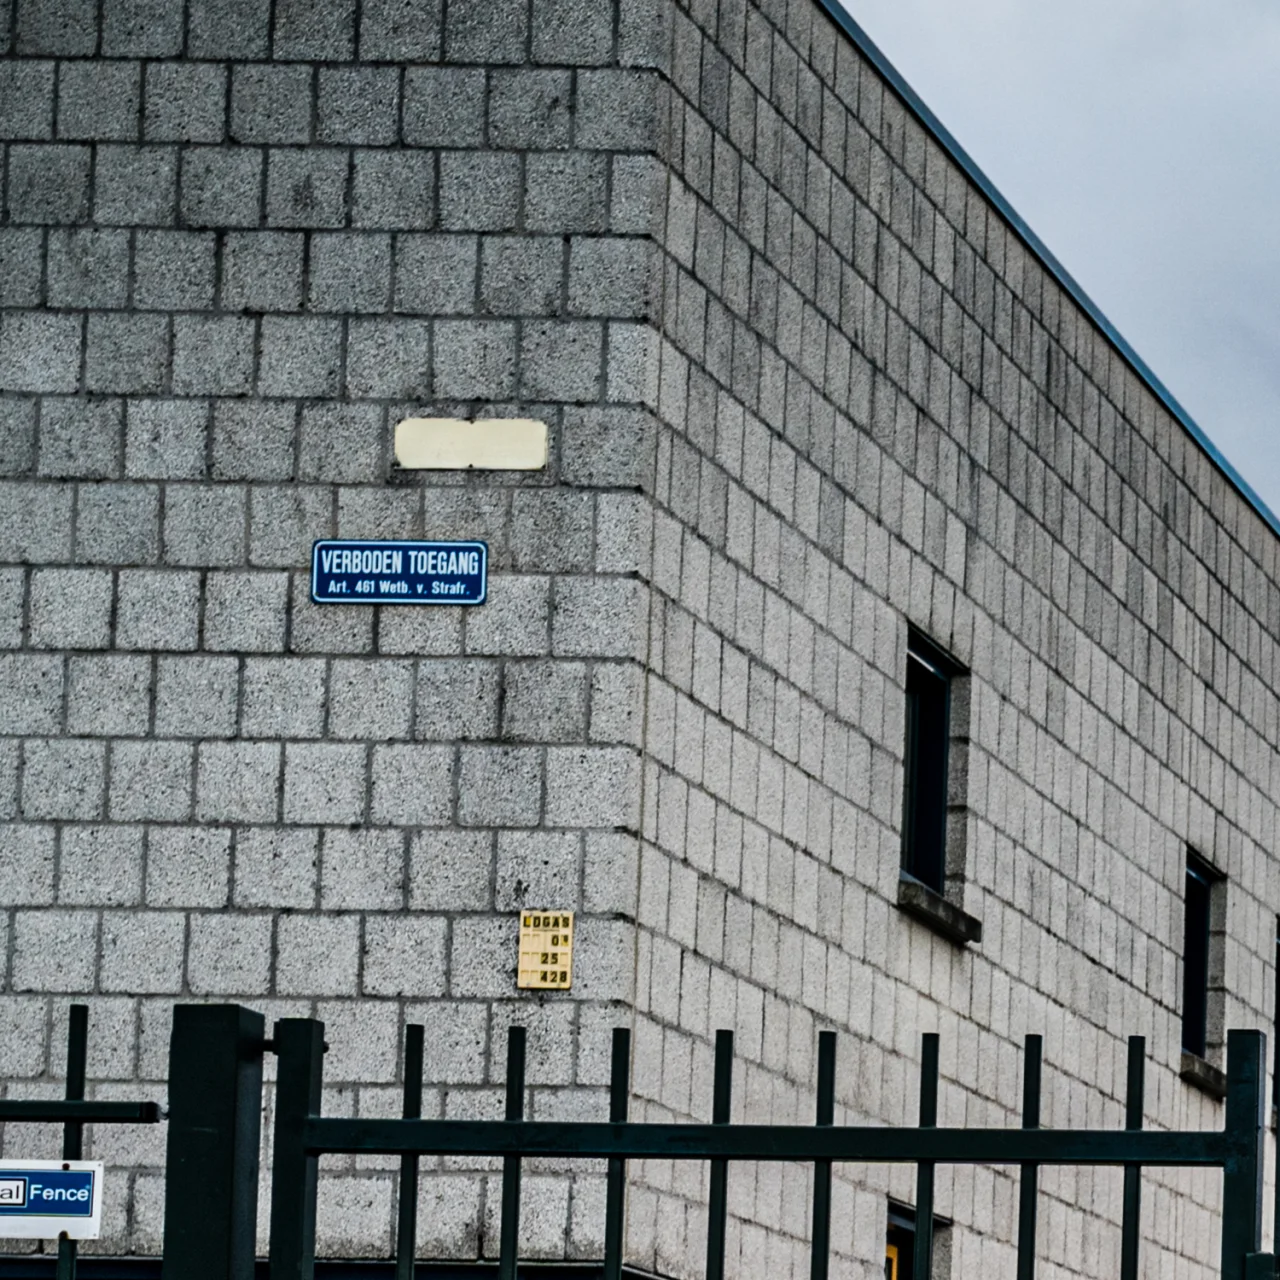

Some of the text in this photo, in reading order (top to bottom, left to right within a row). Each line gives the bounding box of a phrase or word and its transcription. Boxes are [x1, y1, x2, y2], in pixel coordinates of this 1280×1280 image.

[321, 549, 479, 575] VERBODEN TOEGANG
[328, 581, 470, 595] Art. 461 Wetb. v. Strafr.
[541, 952, 559, 965] 25
[540, 970, 568, 983] 428
[30, 1184, 89, 1201] Fence
